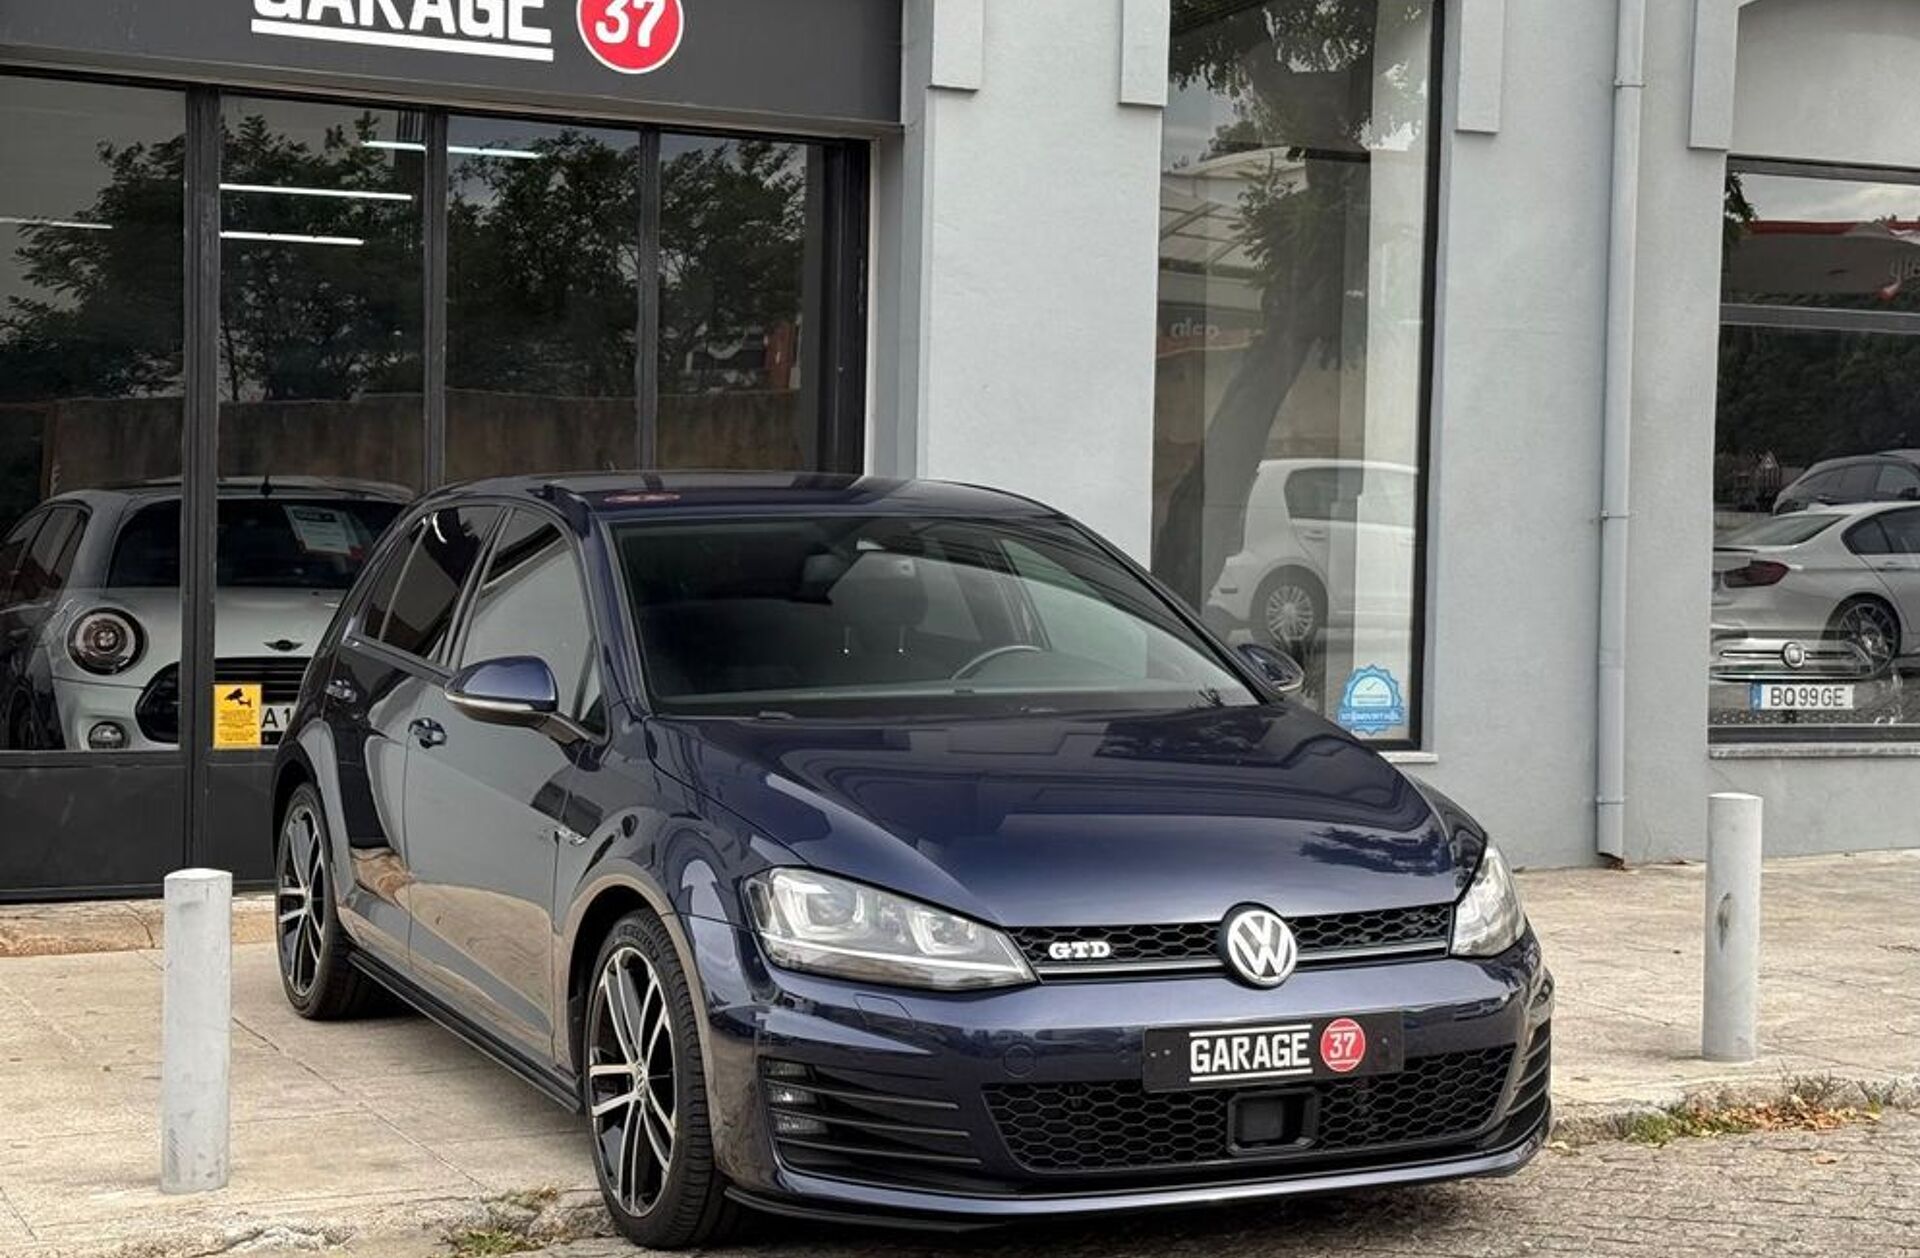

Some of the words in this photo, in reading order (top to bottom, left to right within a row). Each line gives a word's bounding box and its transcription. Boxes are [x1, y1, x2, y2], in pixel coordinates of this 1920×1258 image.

[594, 0, 665, 47] 37
[1049, 941, 1111, 959] GTD
[1190, 1032, 1311, 1074] GARAGE
[1329, 1032, 1357, 1059] 37
